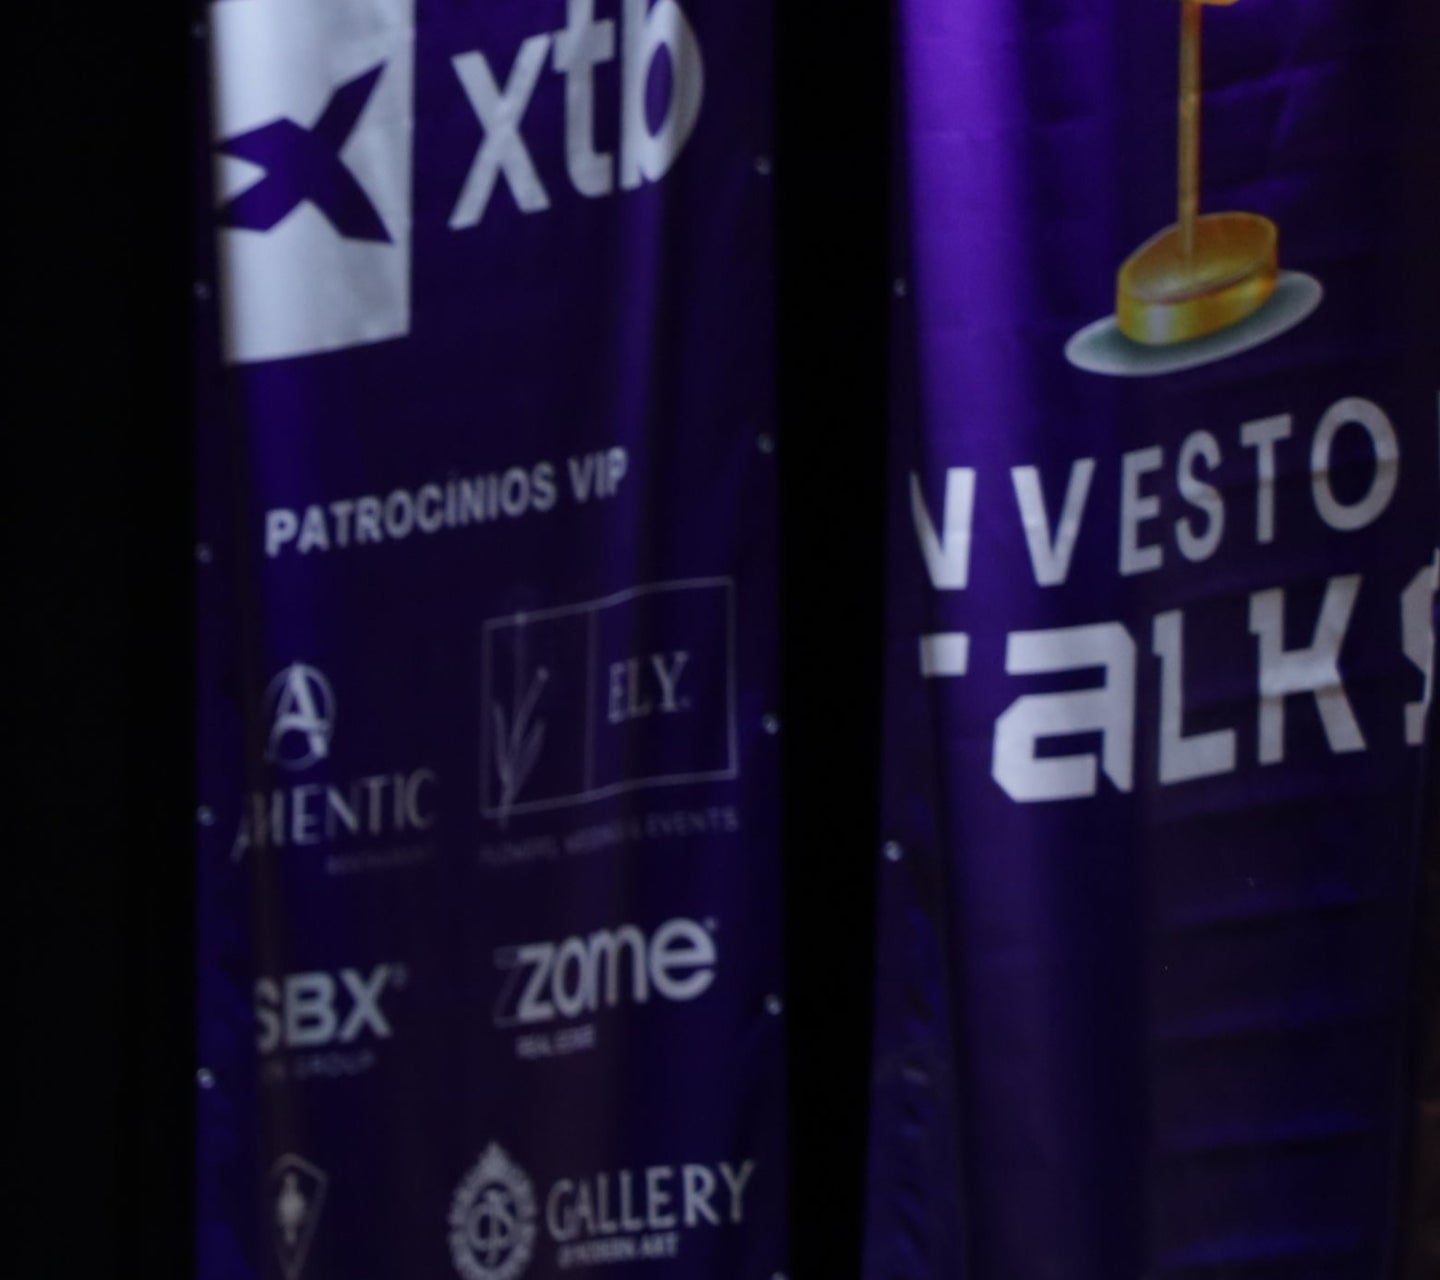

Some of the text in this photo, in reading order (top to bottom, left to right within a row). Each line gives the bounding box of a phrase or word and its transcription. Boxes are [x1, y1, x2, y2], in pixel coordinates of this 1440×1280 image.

[446, 0, 704, 231] xtb
[566, 444, 630, 504] VIP
[545, 1158, 757, 1244] GALLERY
